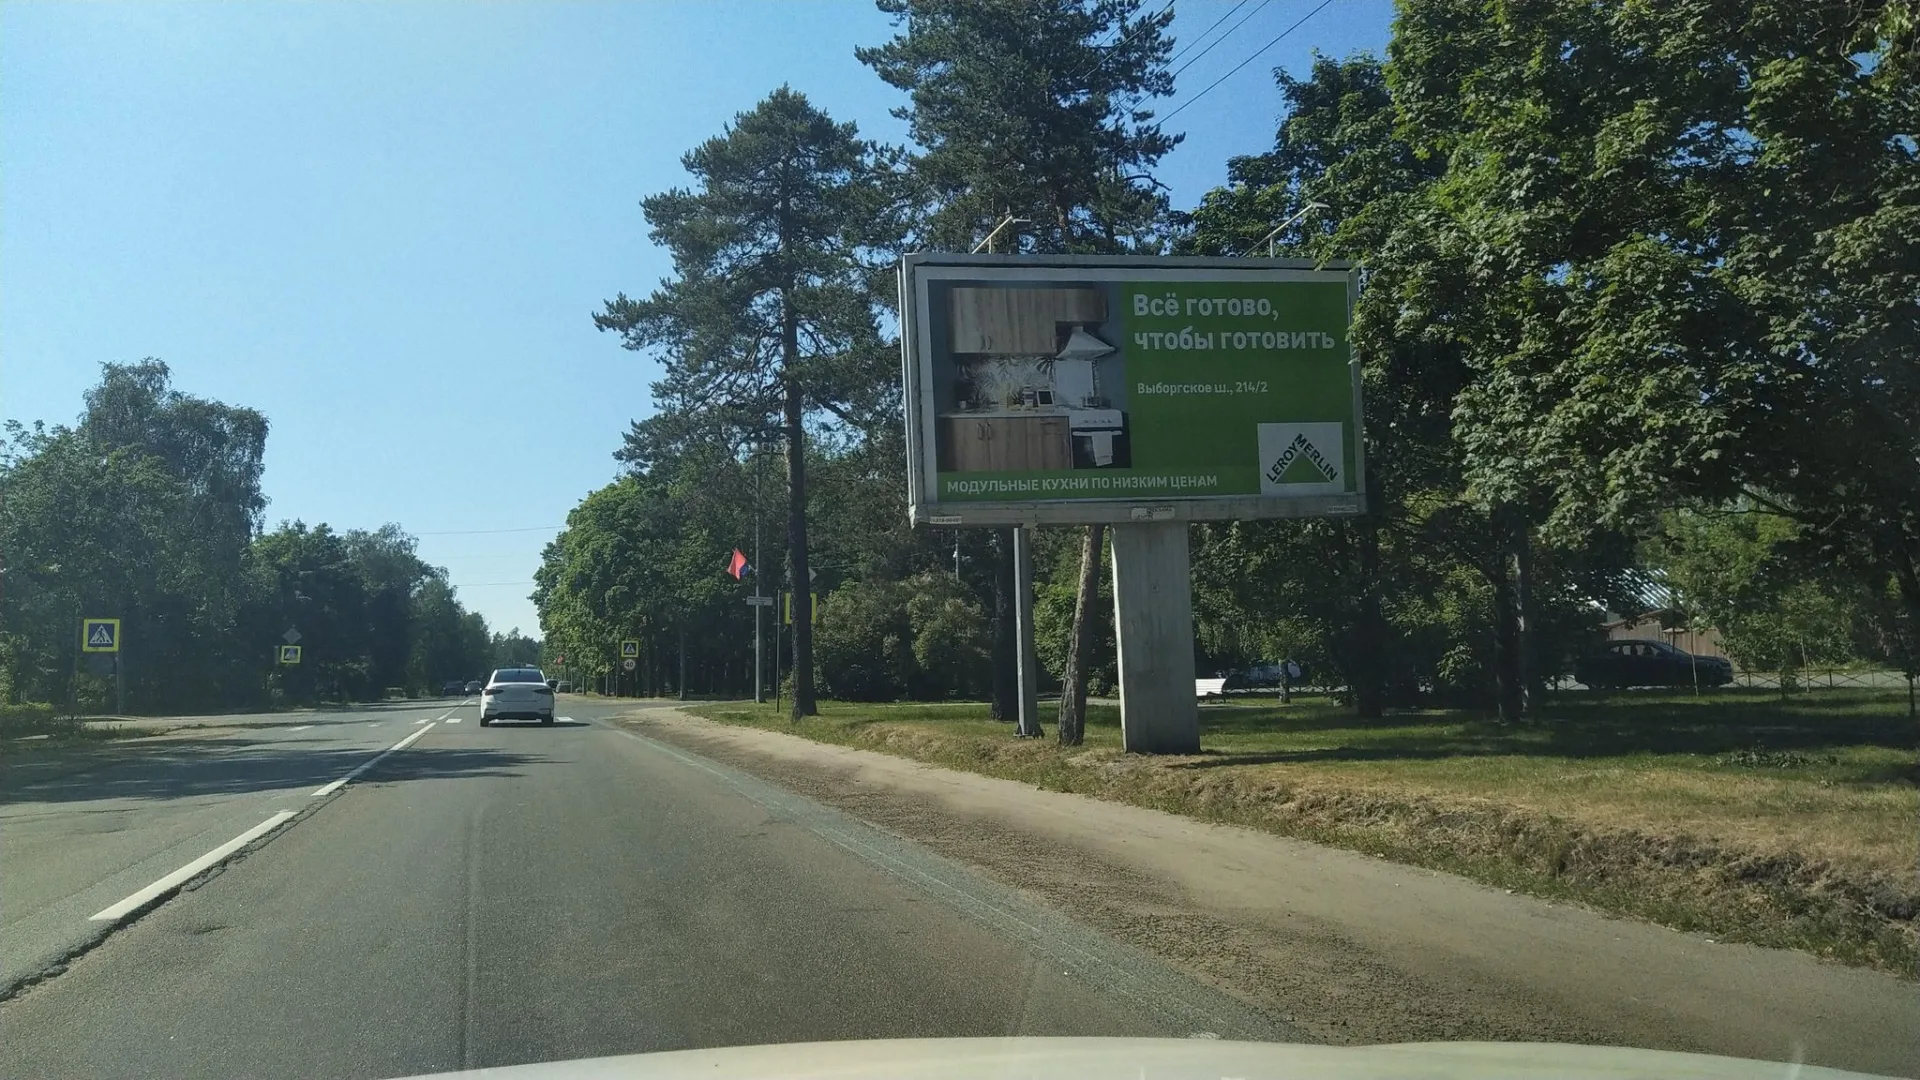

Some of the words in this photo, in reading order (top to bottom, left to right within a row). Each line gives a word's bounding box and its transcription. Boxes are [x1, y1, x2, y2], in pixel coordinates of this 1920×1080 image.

[1133, 292, 1180, 316] Всё
[1186, 298, 1279, 320] готово,
[1134, 325, 1214, 350] чтобы
[1220, 331, 1336, 350] готовить
[1137, 382, 1212, 396] Выборгское
[1214, 384, 1233, 396] ш.,
[1235, 381, 1268, 393] 214/2
[1266, 441, 1299, 482] LEROY
[1294, 433, 1338, 481] MERLIN
[947, 480, 1039, 495] МОДУЛЬНЫЕ
[1042, 478, 1089, 491] КУХНИ
[1091, 477, 1110, 489] ПО
[1113, 476, 1167, 488] НИЗКИМ
[1170, 475, 1217, 489] ЦЕНАМ
[625, 660, 634, 668] 40
